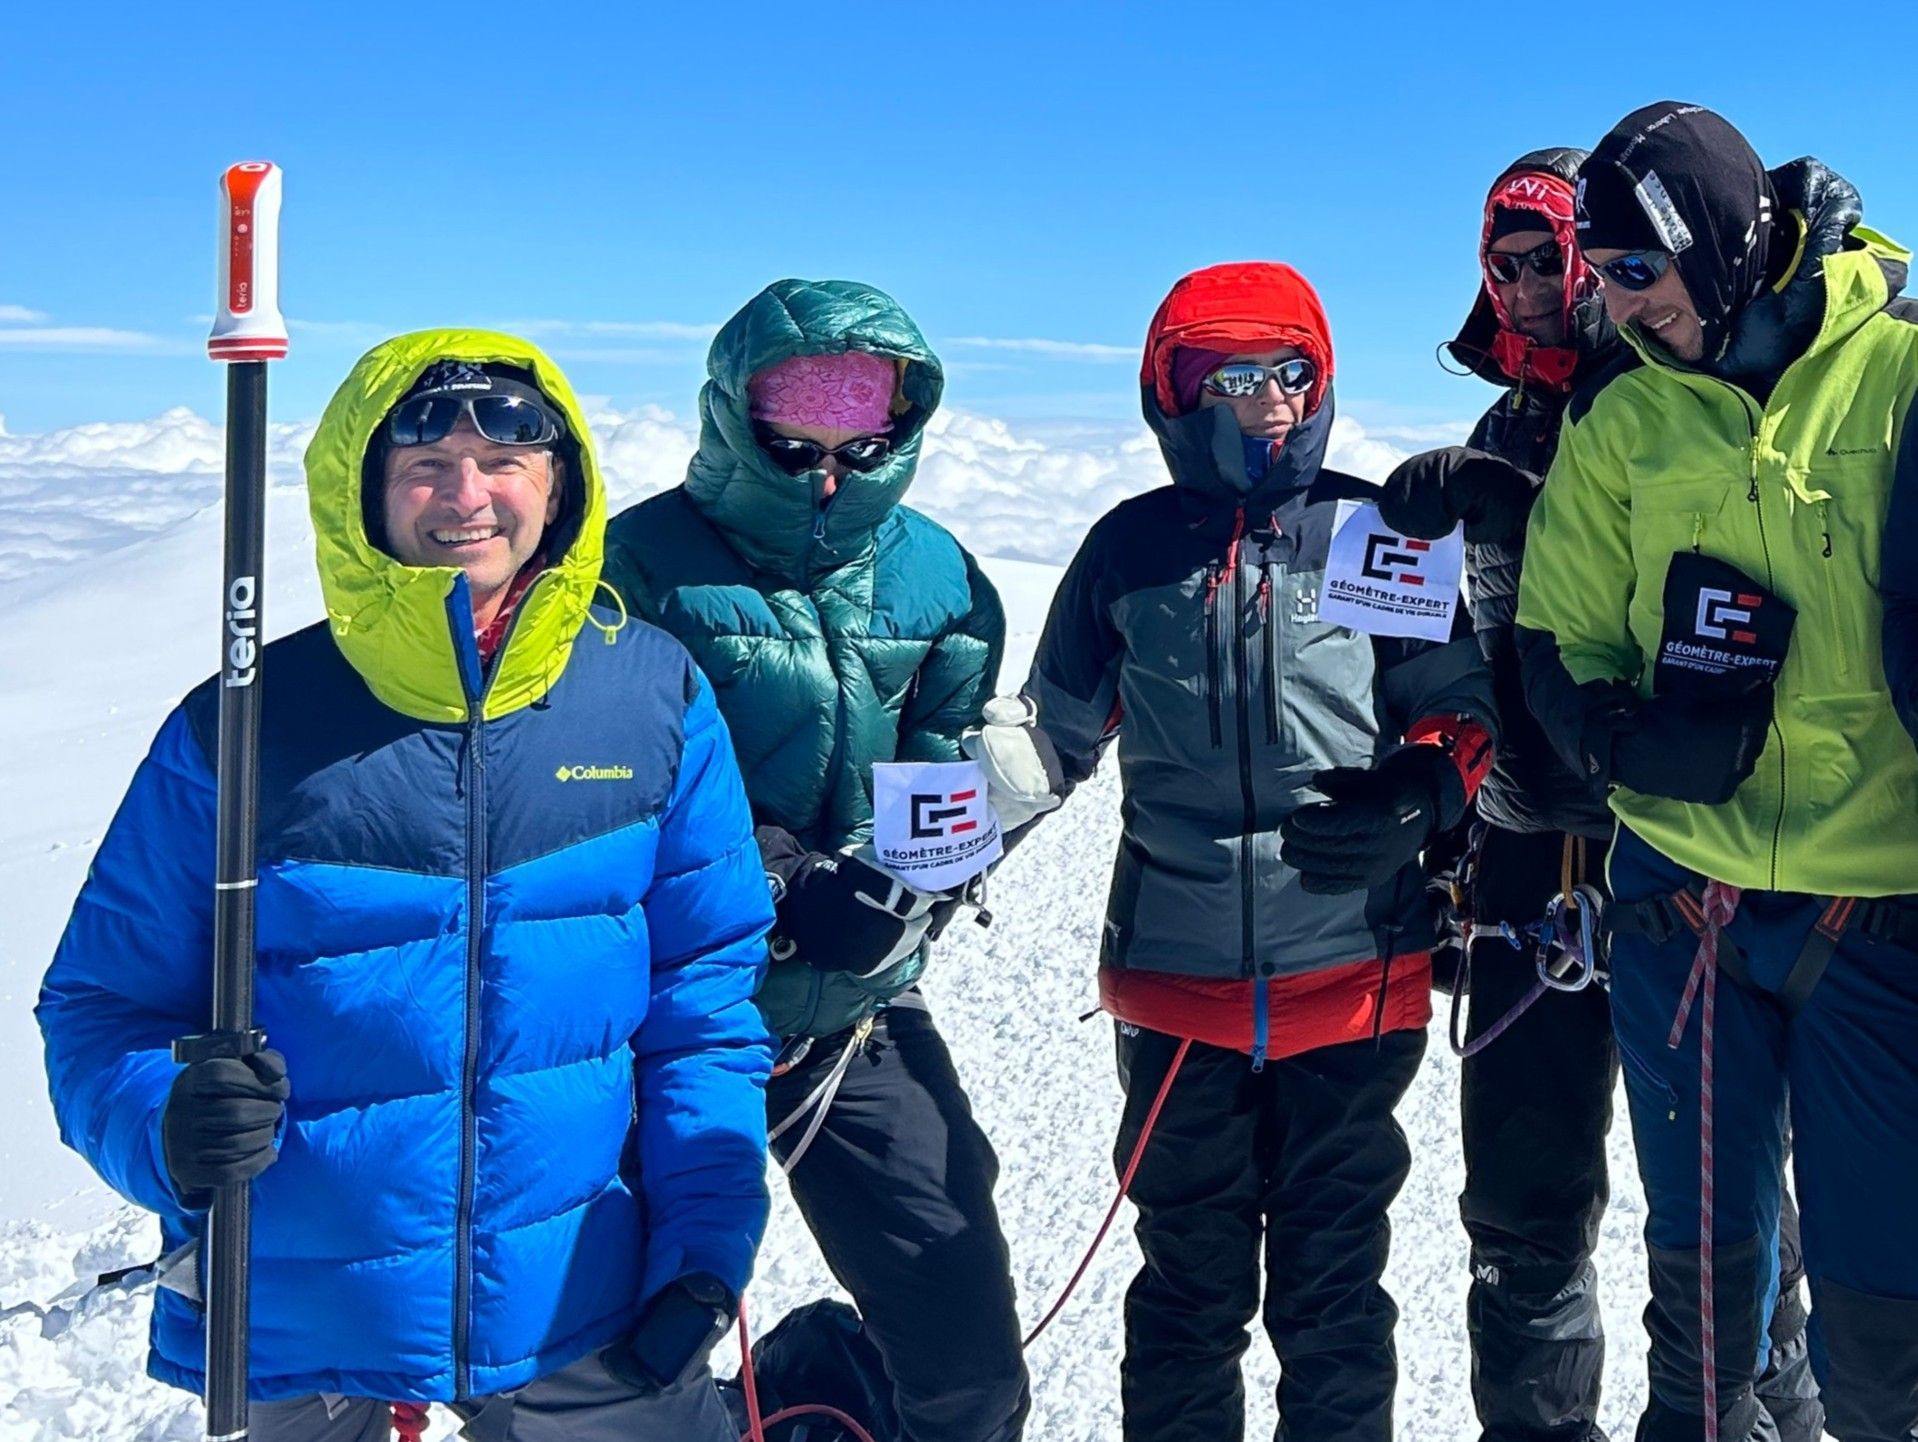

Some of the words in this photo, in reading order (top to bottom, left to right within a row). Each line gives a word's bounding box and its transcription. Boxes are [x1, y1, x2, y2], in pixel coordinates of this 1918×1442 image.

[1330, 579, 1450, 610] GÉOMÈTRE-EXPERT
[226, 576, 256, 688] teria
[571, 765, 633, 780] Columbia
